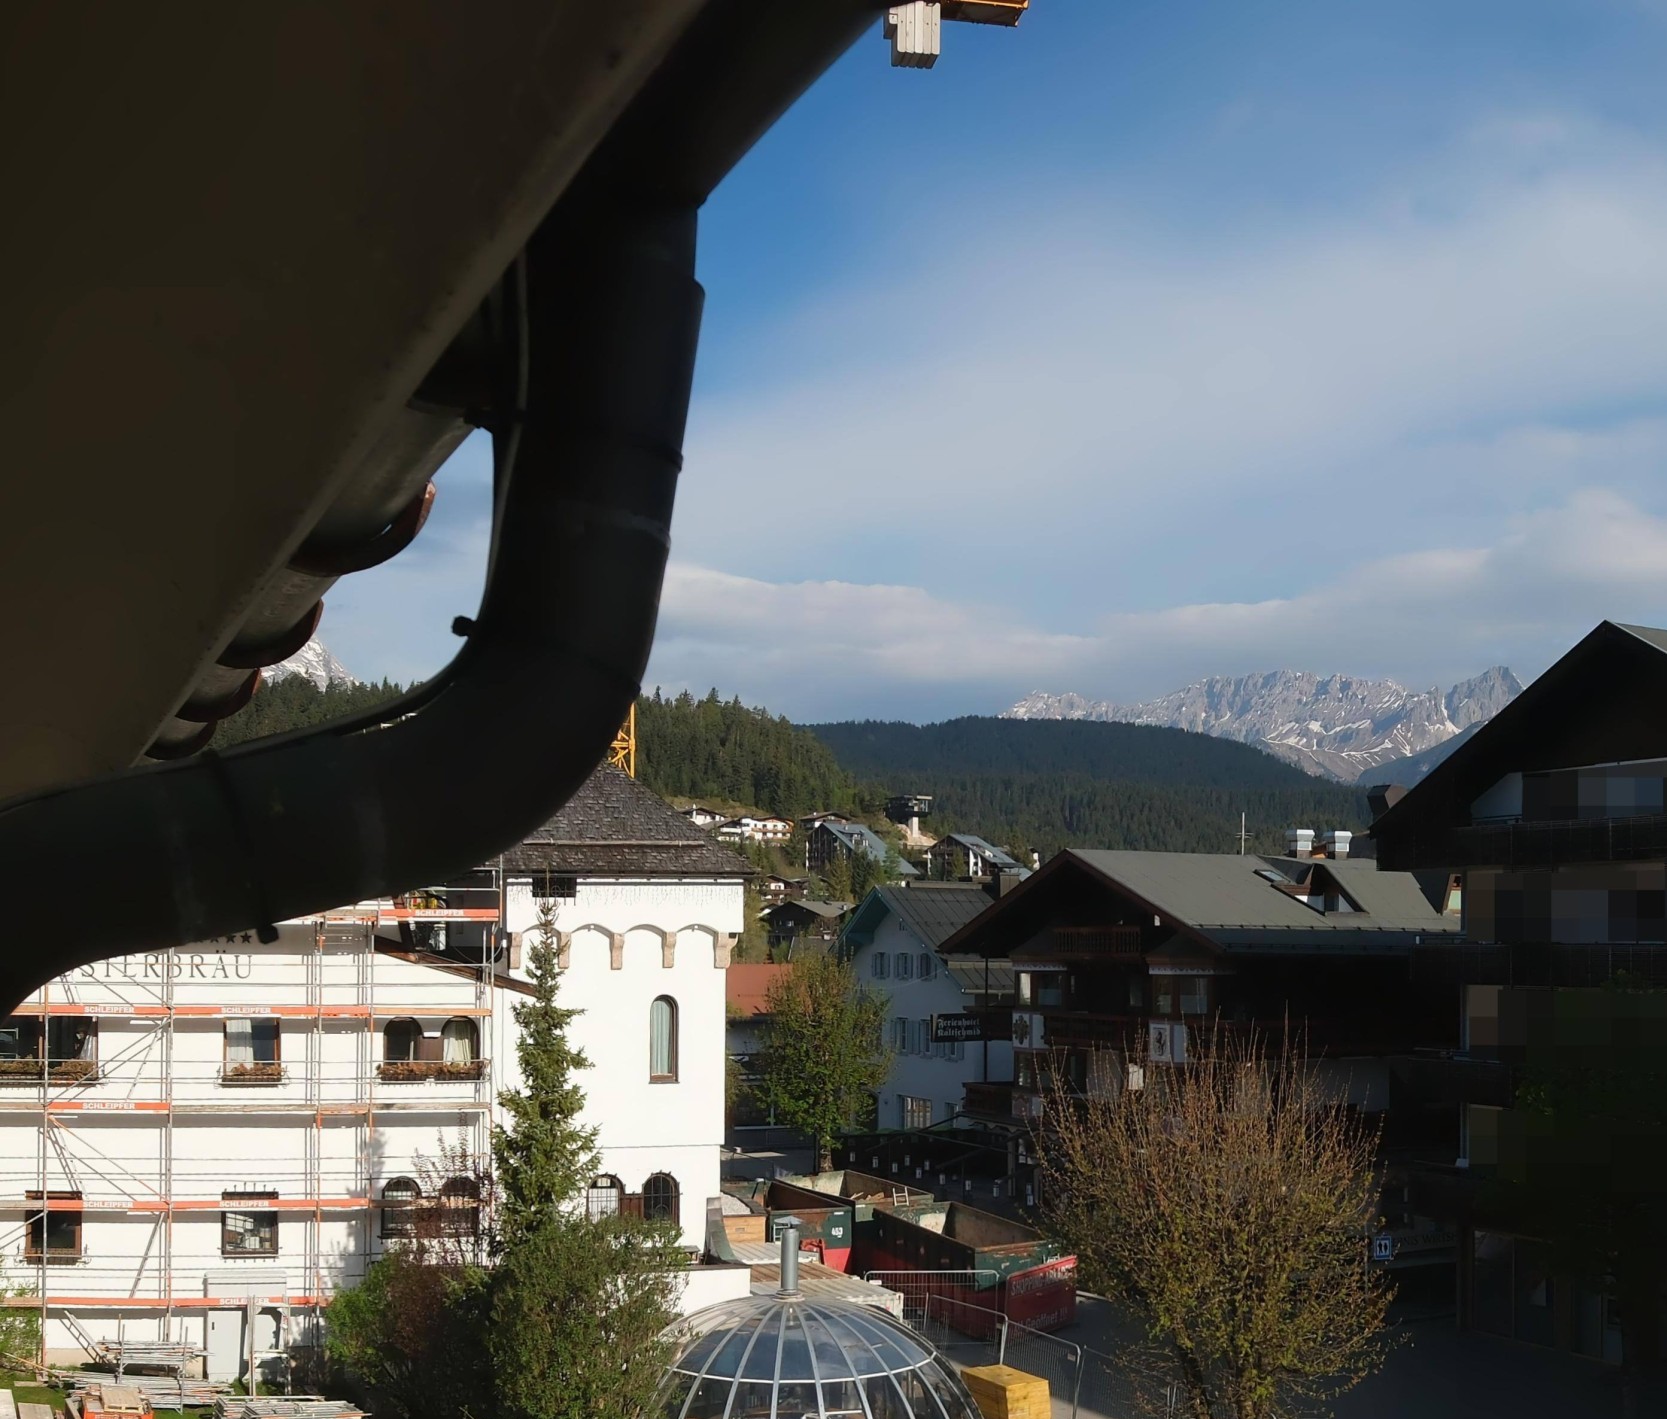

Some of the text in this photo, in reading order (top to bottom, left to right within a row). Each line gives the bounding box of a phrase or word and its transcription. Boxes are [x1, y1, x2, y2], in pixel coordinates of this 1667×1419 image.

[415, 909, 464, 917] SCHLEIPFER
[61, 950, 253, 979] STERBRÄU
[84, 1006, 134, 1014] SCHLEIPFER
[221, 1006, 271, 1014] SCHLEIPFER
[82, 1102, 135, 1110] SCHLEIPFER
[83, 1201, 134, 1209] SCHLEIPFER
[219, 1200, 269, 1208] SCHLEIPFER
